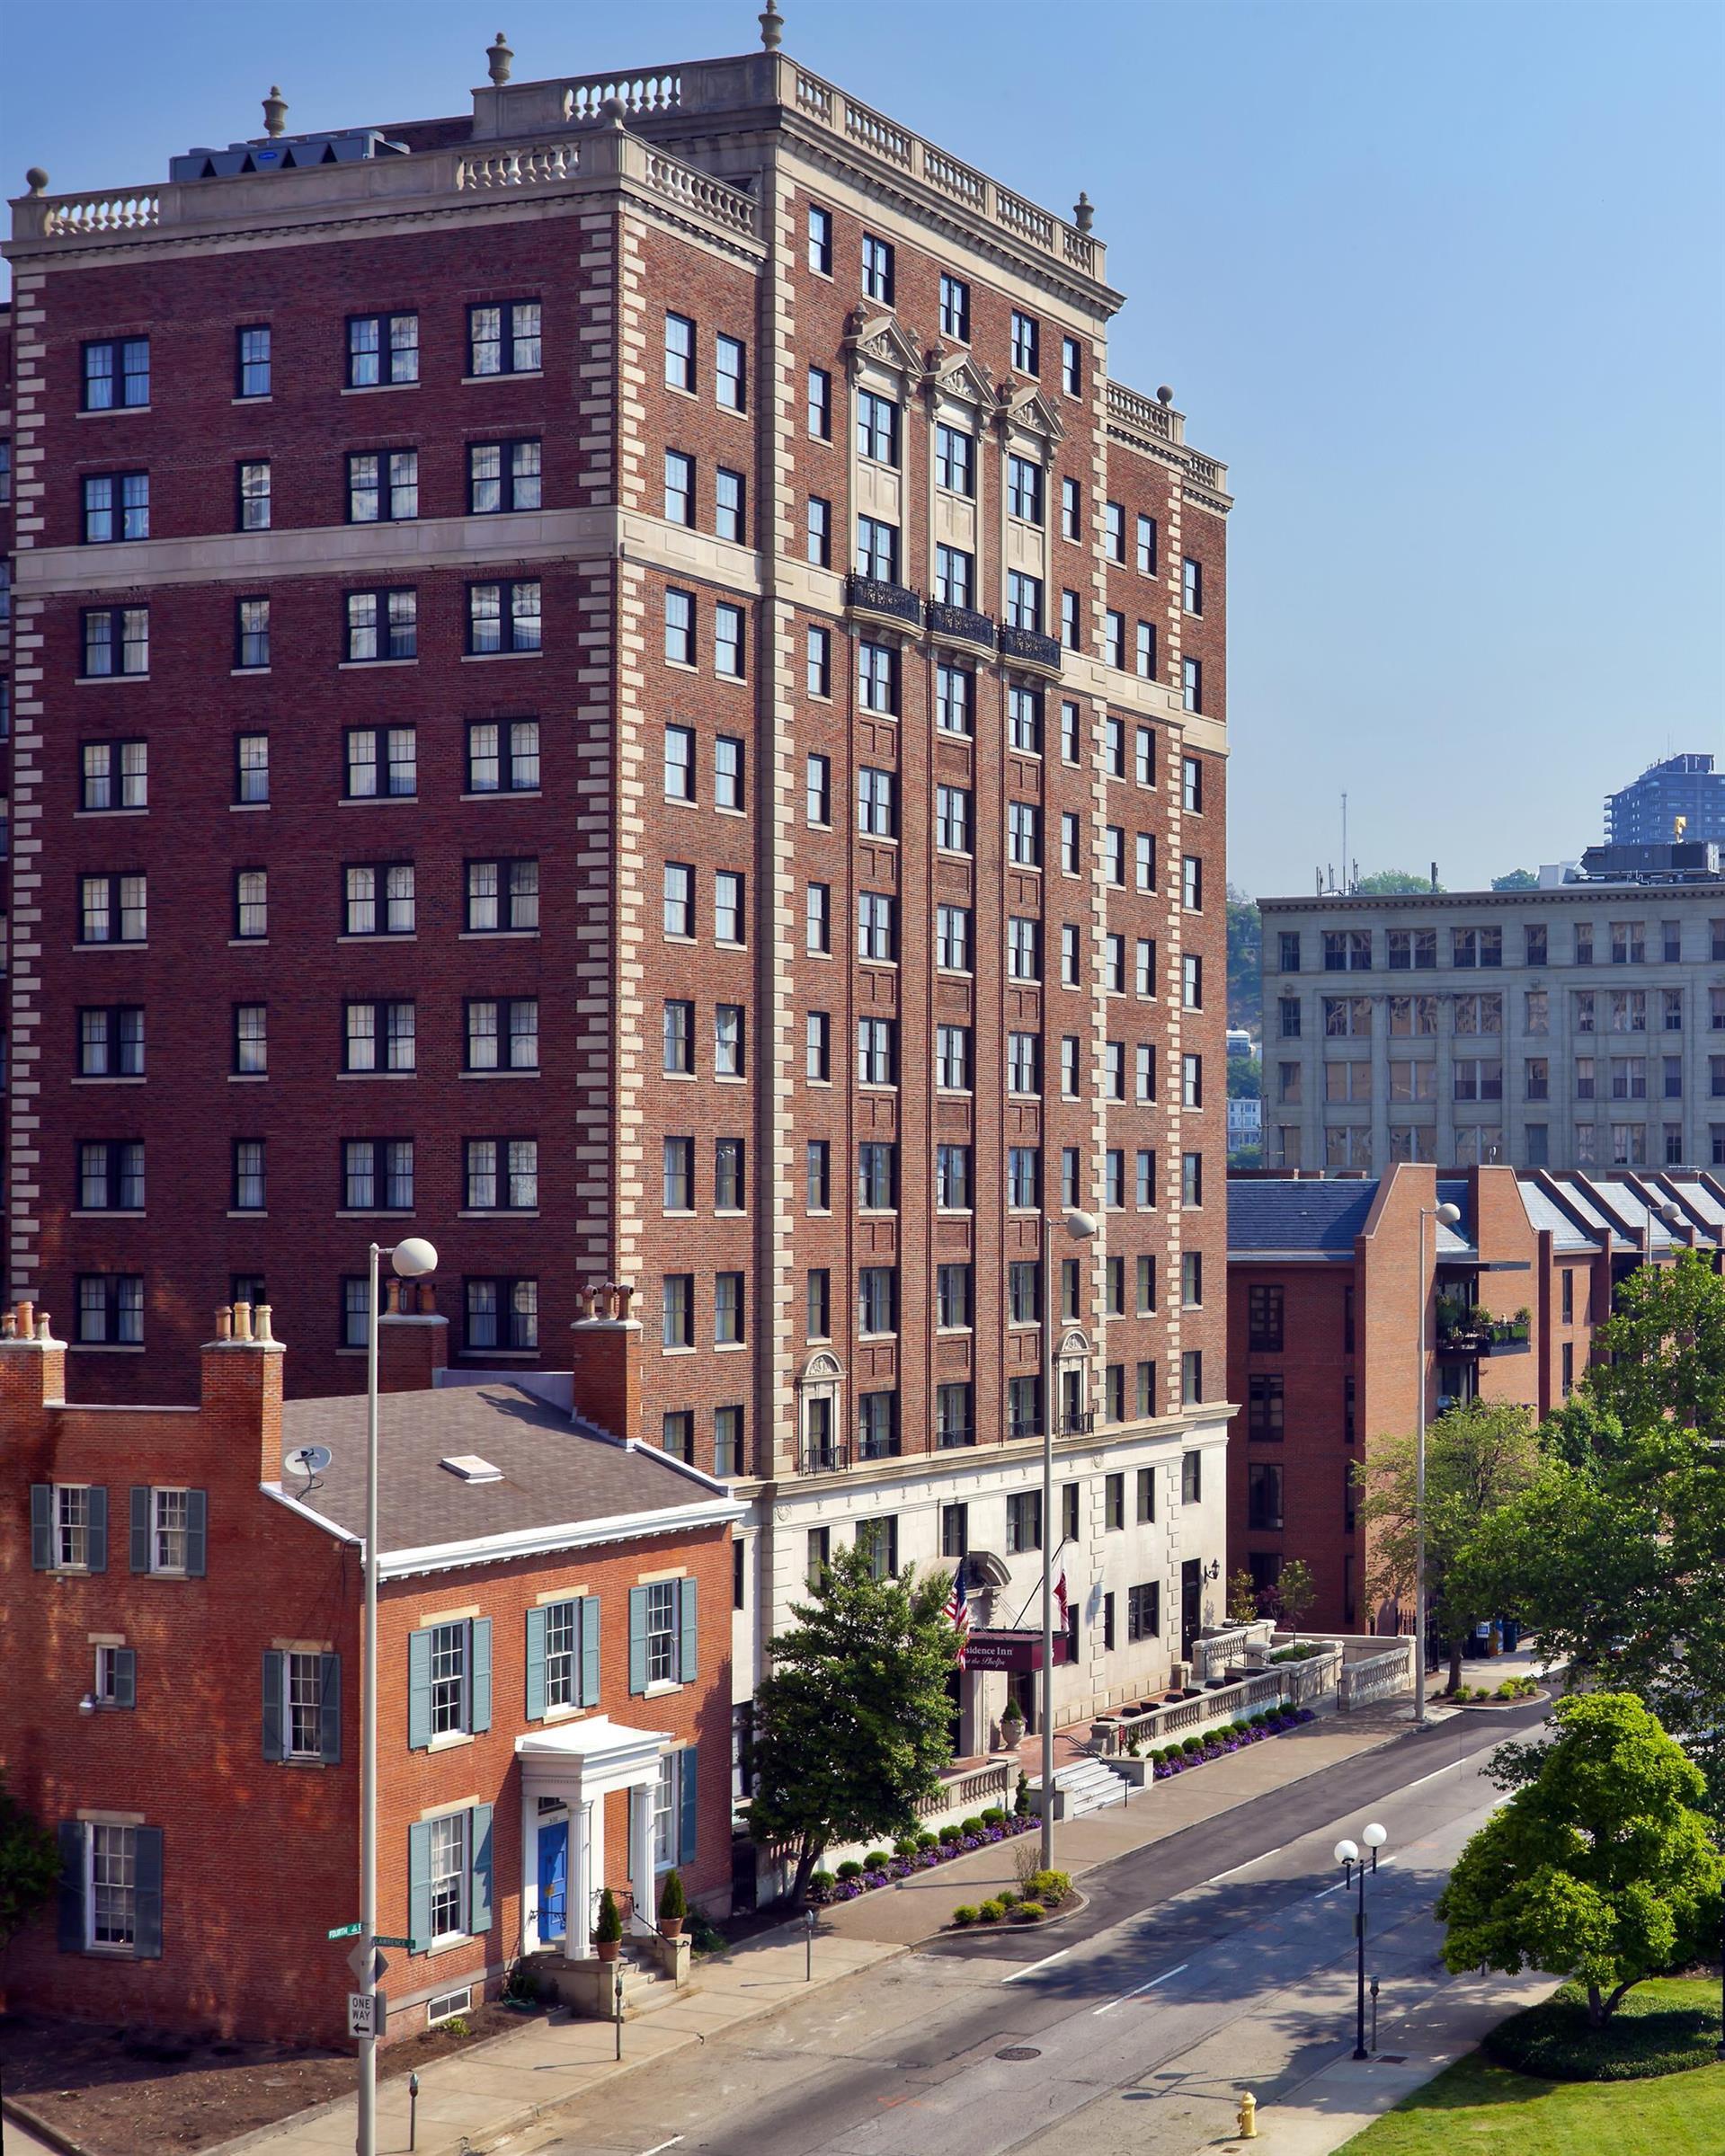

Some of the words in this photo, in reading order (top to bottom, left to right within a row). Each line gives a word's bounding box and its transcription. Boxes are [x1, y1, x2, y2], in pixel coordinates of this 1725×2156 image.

[965, 1646, 995, 1655] sidence
[997, 1646, 1012, 1655] Inn
[328, 1927, 348, 1939] FOURTH
[352, 1997, 370, 2010] ONE
[351, 2010, 370, 2021] WAY
